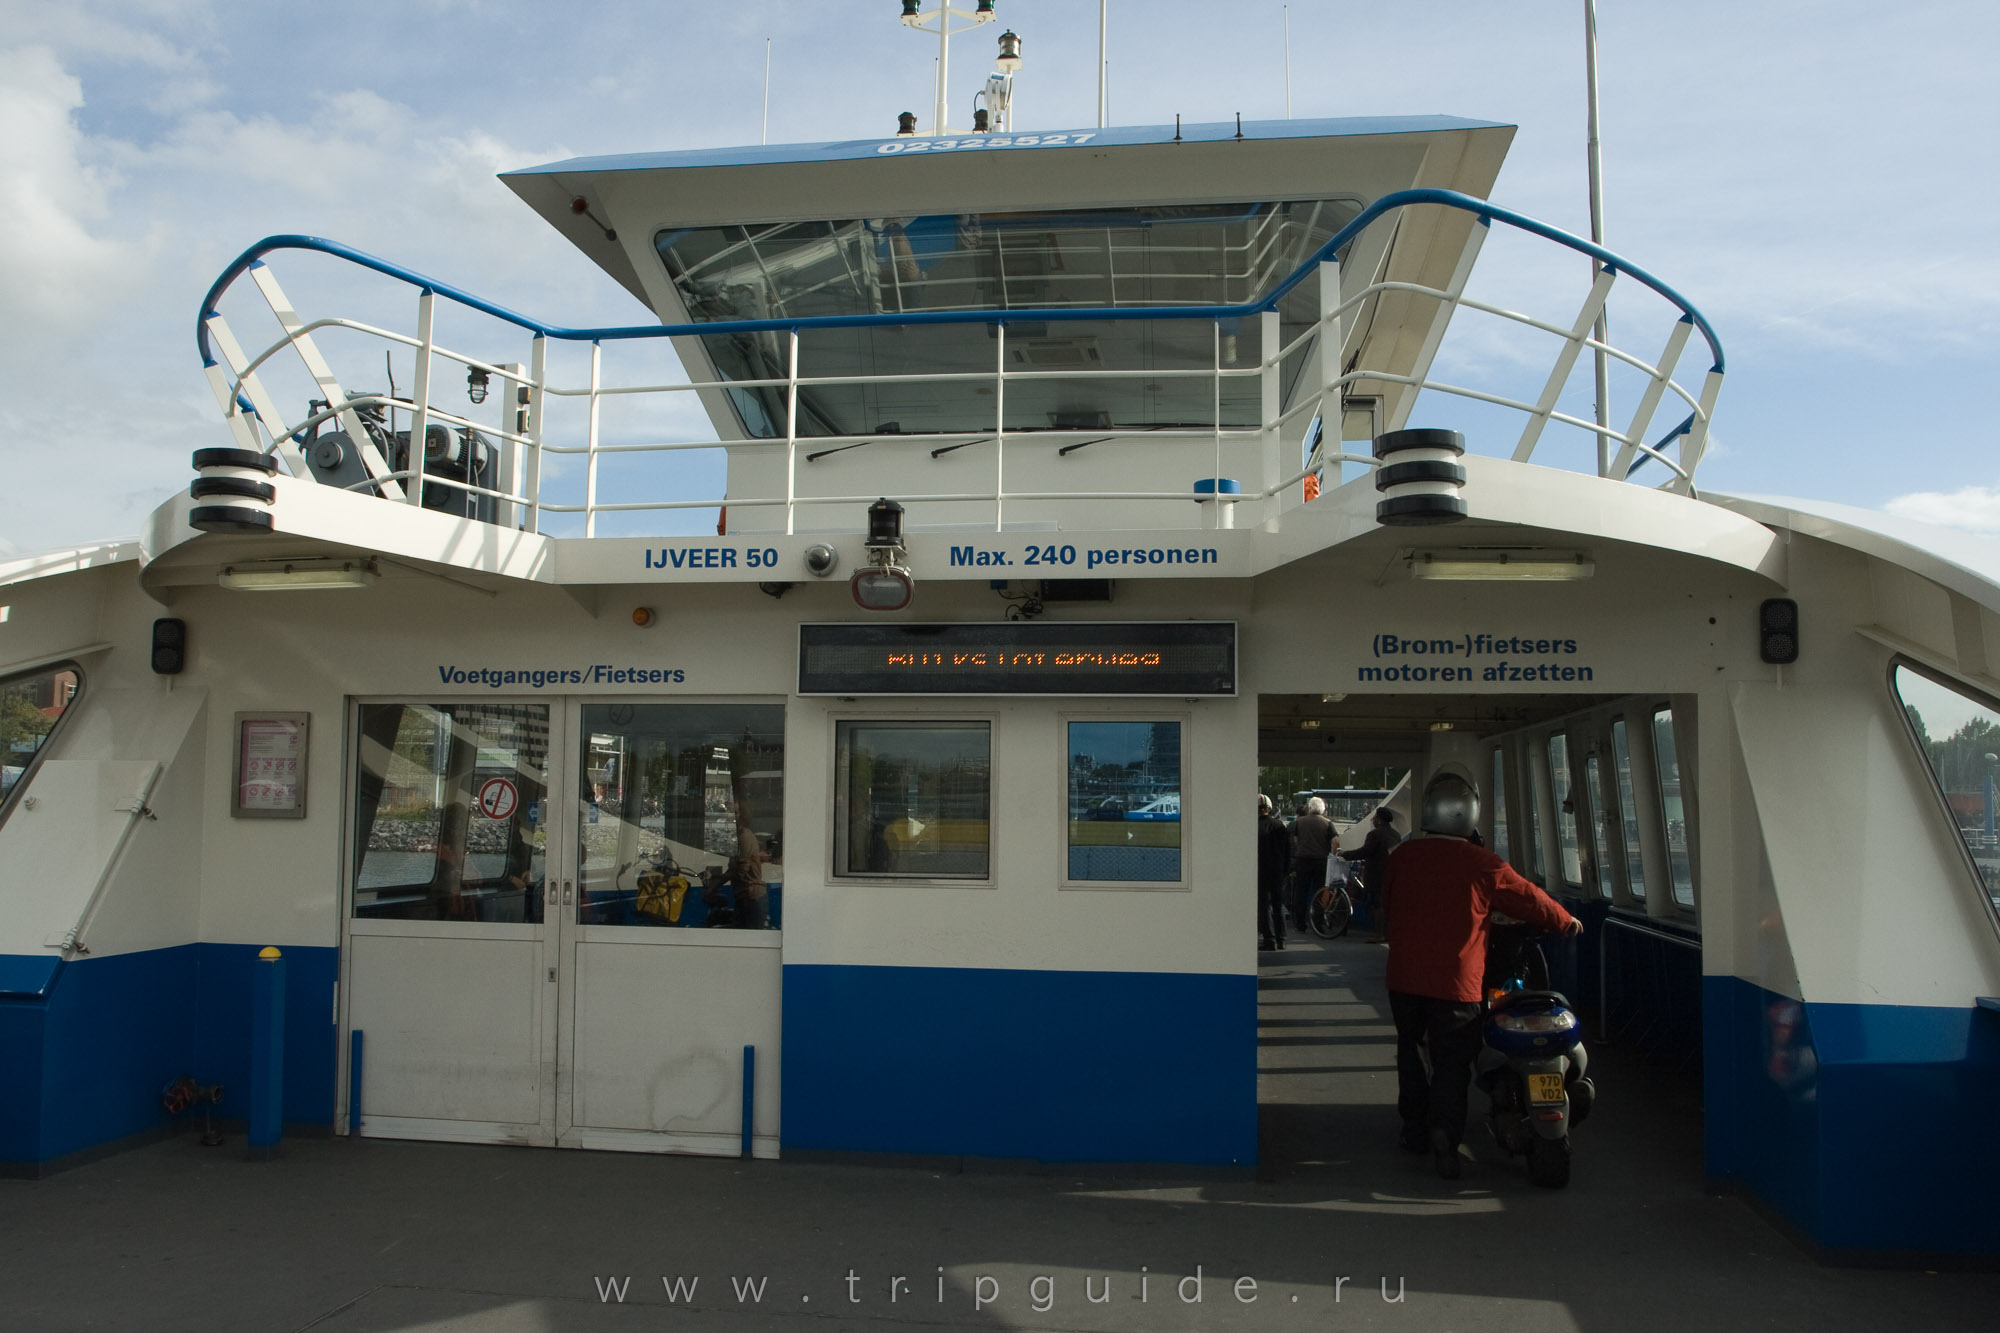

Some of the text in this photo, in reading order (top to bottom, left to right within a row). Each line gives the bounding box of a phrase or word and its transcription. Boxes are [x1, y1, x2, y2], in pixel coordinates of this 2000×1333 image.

[877, 133, 1096, 154] 02325527
[645, 548, 779, 569] IJVEER 50
[950, 545, 1218, 569] Max. 240 personen
[1373, 634, 1578, 658] (Brom-)fietsers
[438, 665, 686, 688] Voetgangers/Fietsers
[1358, 661, 1594, 682] motoren afzetten
[1539, 1075, 1561, 1087] 97D
[1541, 1088, 1563, 1100] VD2
